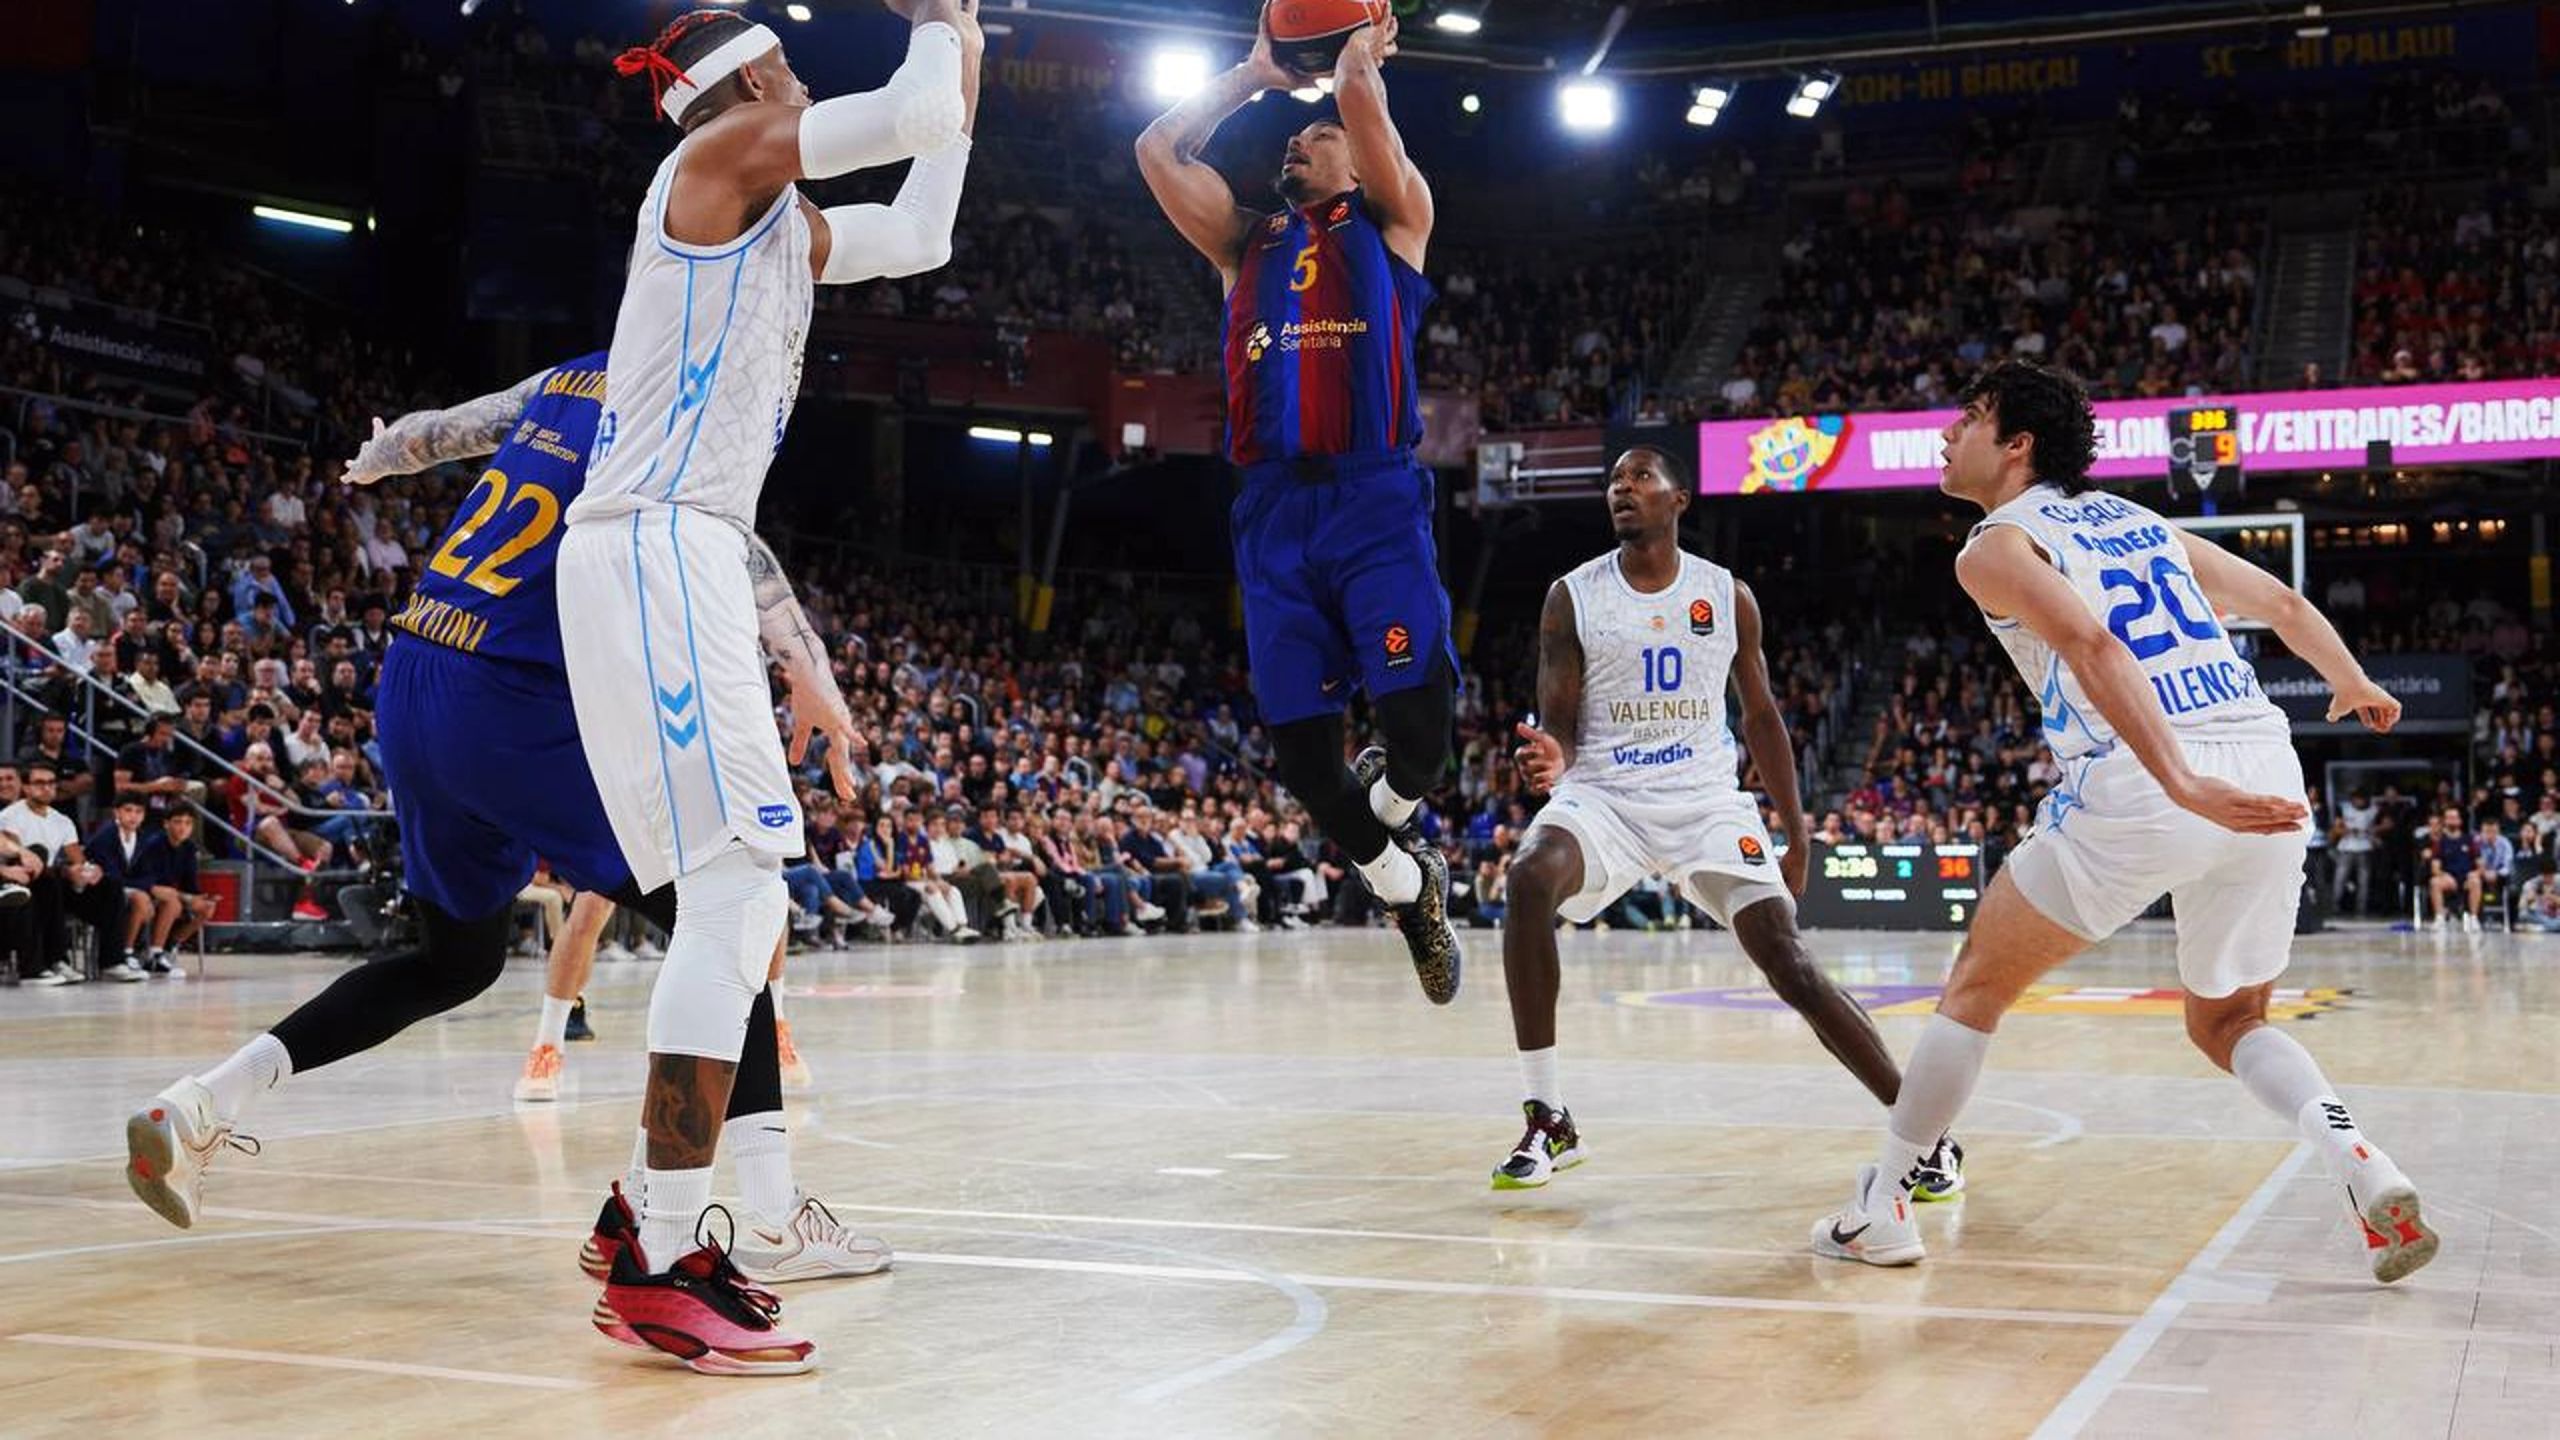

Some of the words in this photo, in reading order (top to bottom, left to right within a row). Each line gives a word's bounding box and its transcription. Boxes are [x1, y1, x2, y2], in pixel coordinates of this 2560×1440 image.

[1290, 243, 1319, 292] 5
[2214, 433, 2237, 465] 9
[429, 469, 559, 598] 22
[2101, 556, 2223, 661] 20
[1641, 646, 1683, 693] 10
[1609, 698, 1712, 723] VALENCIA
